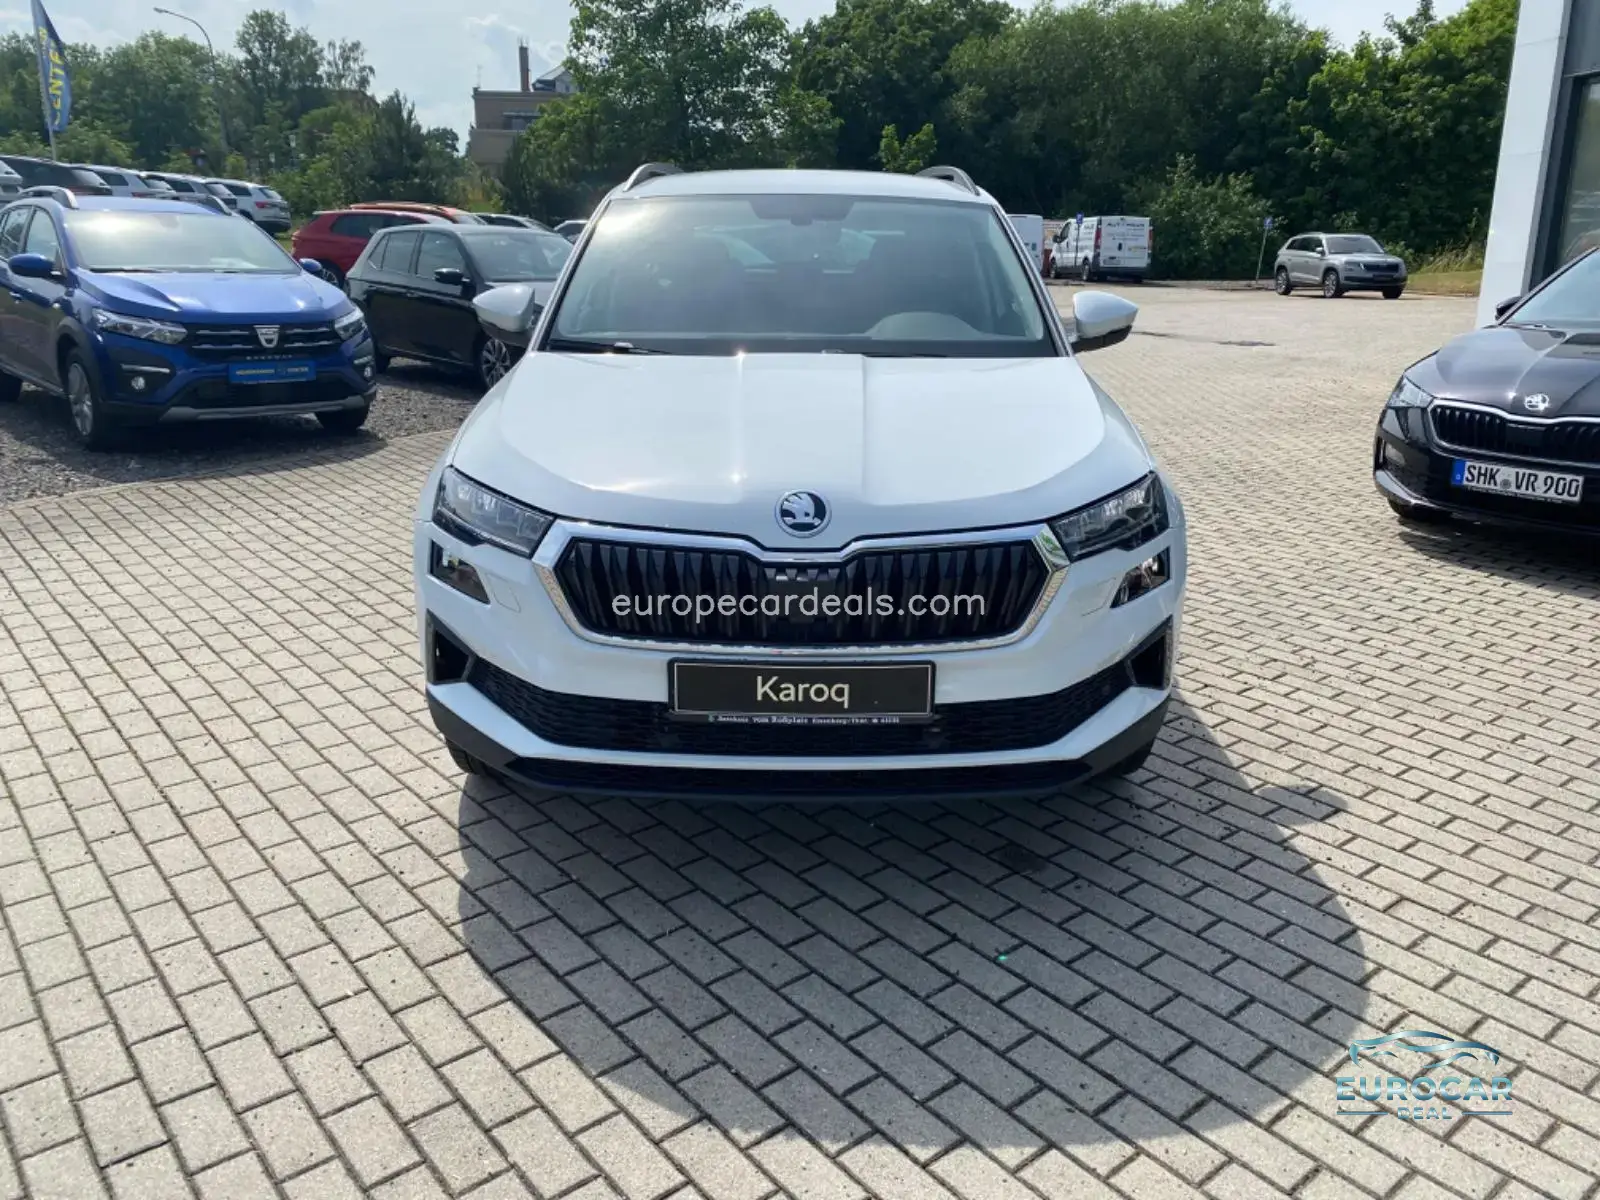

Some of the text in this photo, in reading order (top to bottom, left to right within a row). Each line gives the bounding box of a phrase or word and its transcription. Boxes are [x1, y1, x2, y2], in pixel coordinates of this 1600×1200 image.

[1466, 465, 1500, 486] SHK
[1514, 471, 1539, 493] VR
[1543, 475, 1581, 499] 900
[756, 675, 850, 709] Karoq
